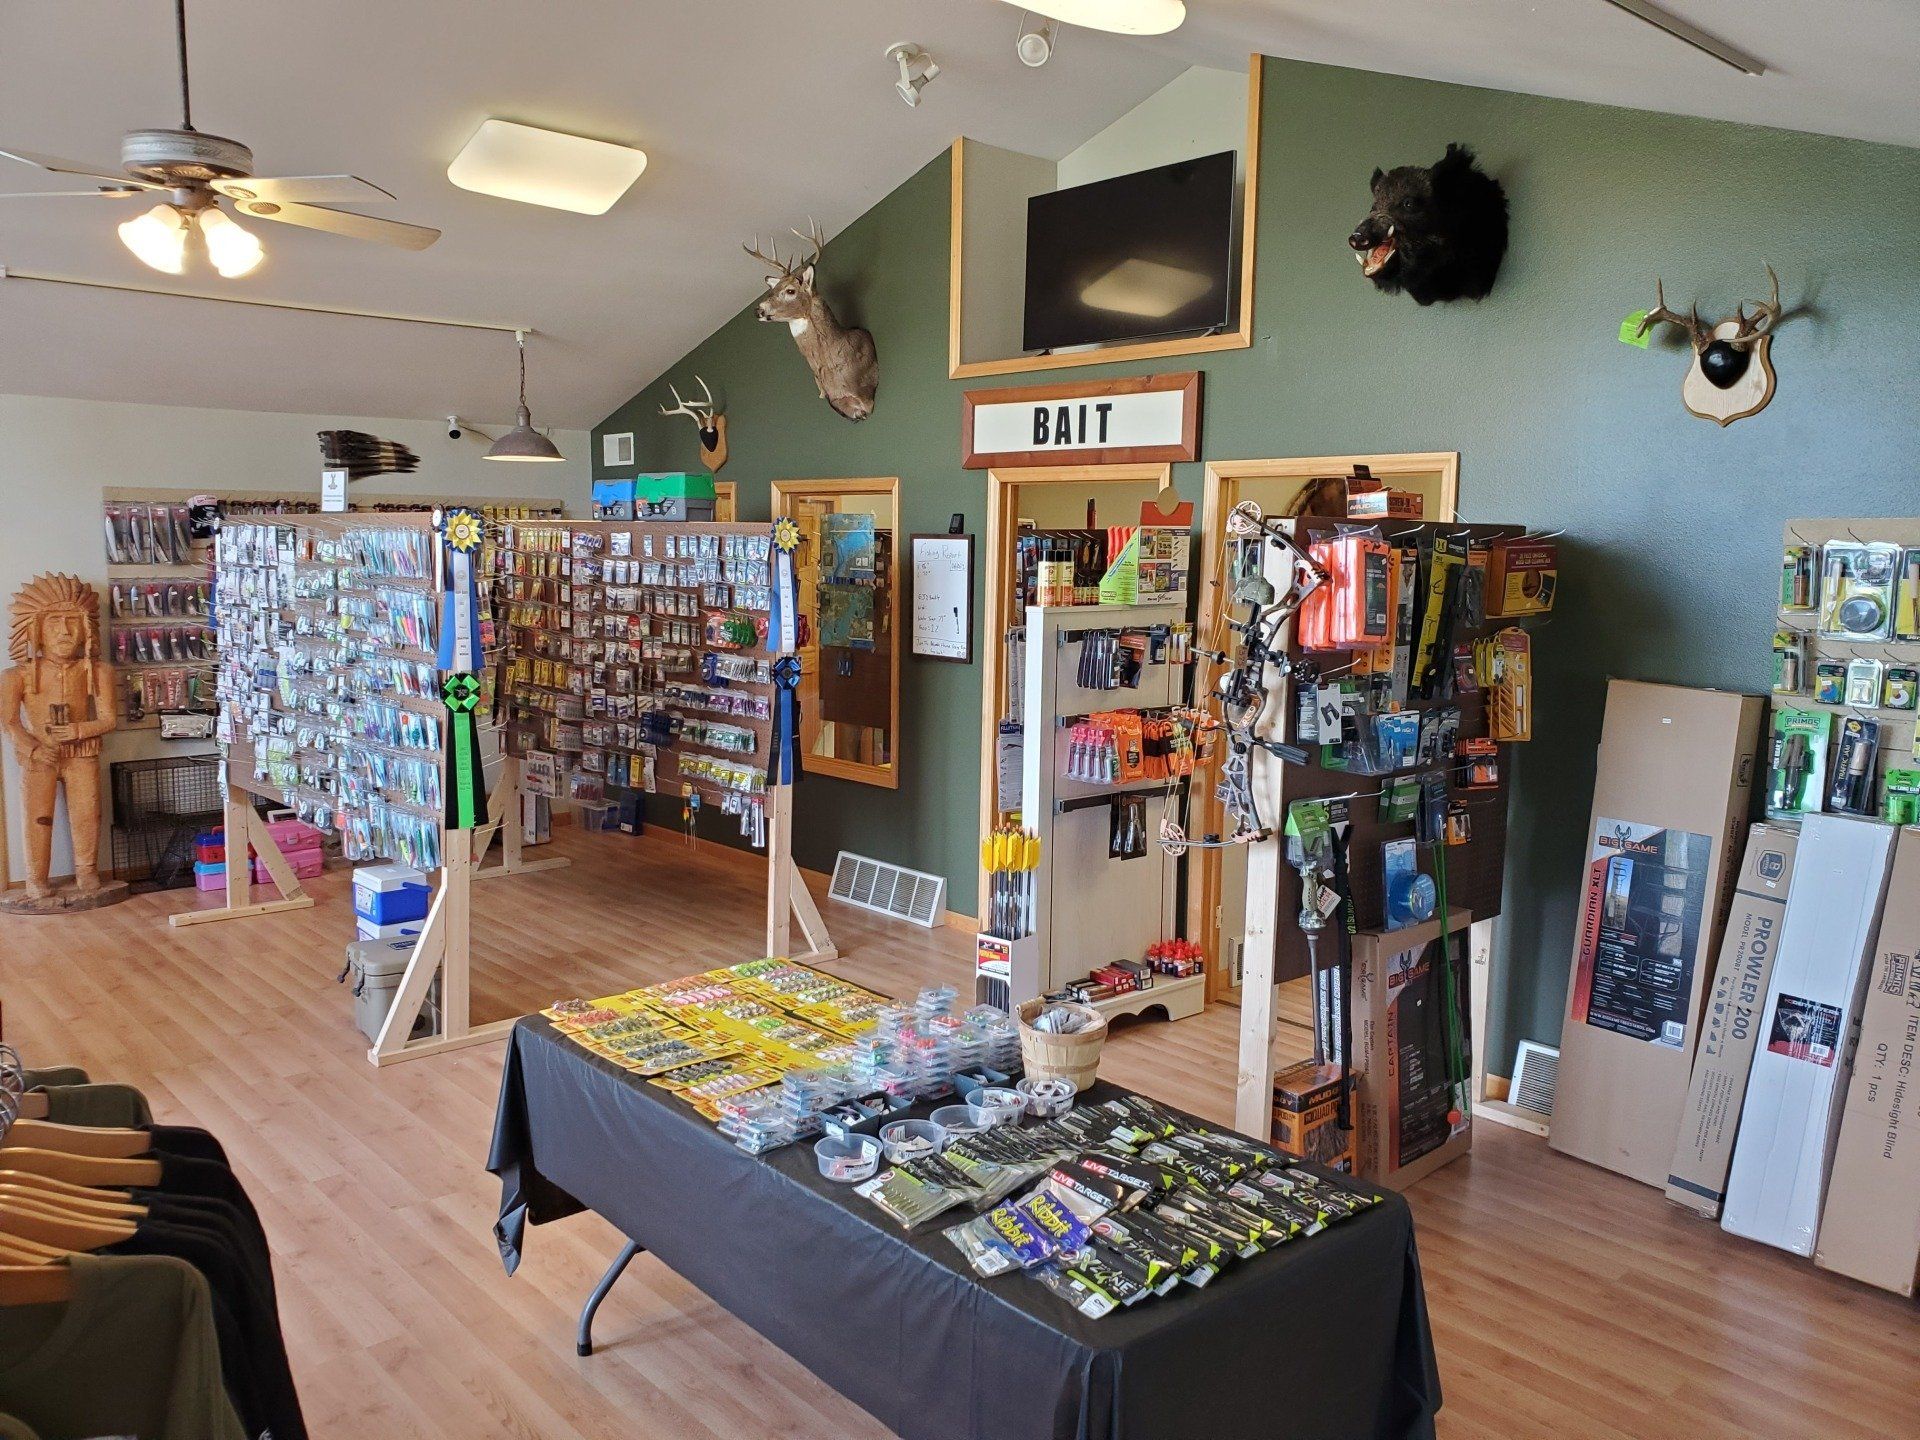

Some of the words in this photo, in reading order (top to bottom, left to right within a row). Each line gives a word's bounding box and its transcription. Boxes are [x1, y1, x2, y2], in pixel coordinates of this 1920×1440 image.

[1033, 402, 1112, 445] BAIT
[1786, 716, 1820, 726] PRIMOS
[1838, 757, 1849, 780] TRAFFIC
[1599, 835, 1620, 849] BIG
[1625, 841, 1658, 854] GAME
[1583, 892, 1598, 956] GUARDIAN
[1592, 868, 1601, 888] XLT
[1742, 913, 1753, 938] MODEL
[1389, 972, 1405, 989] BIG
[1407, 962, 1431, 980] GAME
[1738, 916, 1773, 1004] PROWLER
[1889, 955, 1906, 995] PRIMOS
[1731, 1005, 1752, 1040] 200
[1905, 1015, 1919, 1042] ITEM
[1387, 1011, 1395, 1077] CAPTAIN
[1874, 1042, 1888, 1069] QTY:
[1898, 1044, 1914, 1077] DESC:
[1308, 1088, 1339, 1105] MUDD
[1867, 1082, 1878, 1102] pcs
[1888, 1080, 1907, 1130] Hidesight
[1883, 1131, 1897, 1160] Blind
[1052, 1169, 1113, 1207] LIVETARGET
[1083, 1160, 1151, 1190] LIVETARGET
[991, 1208, 1034, 1247] Ribbit
[1026, 1195, 1072, 1238] Ribbit
